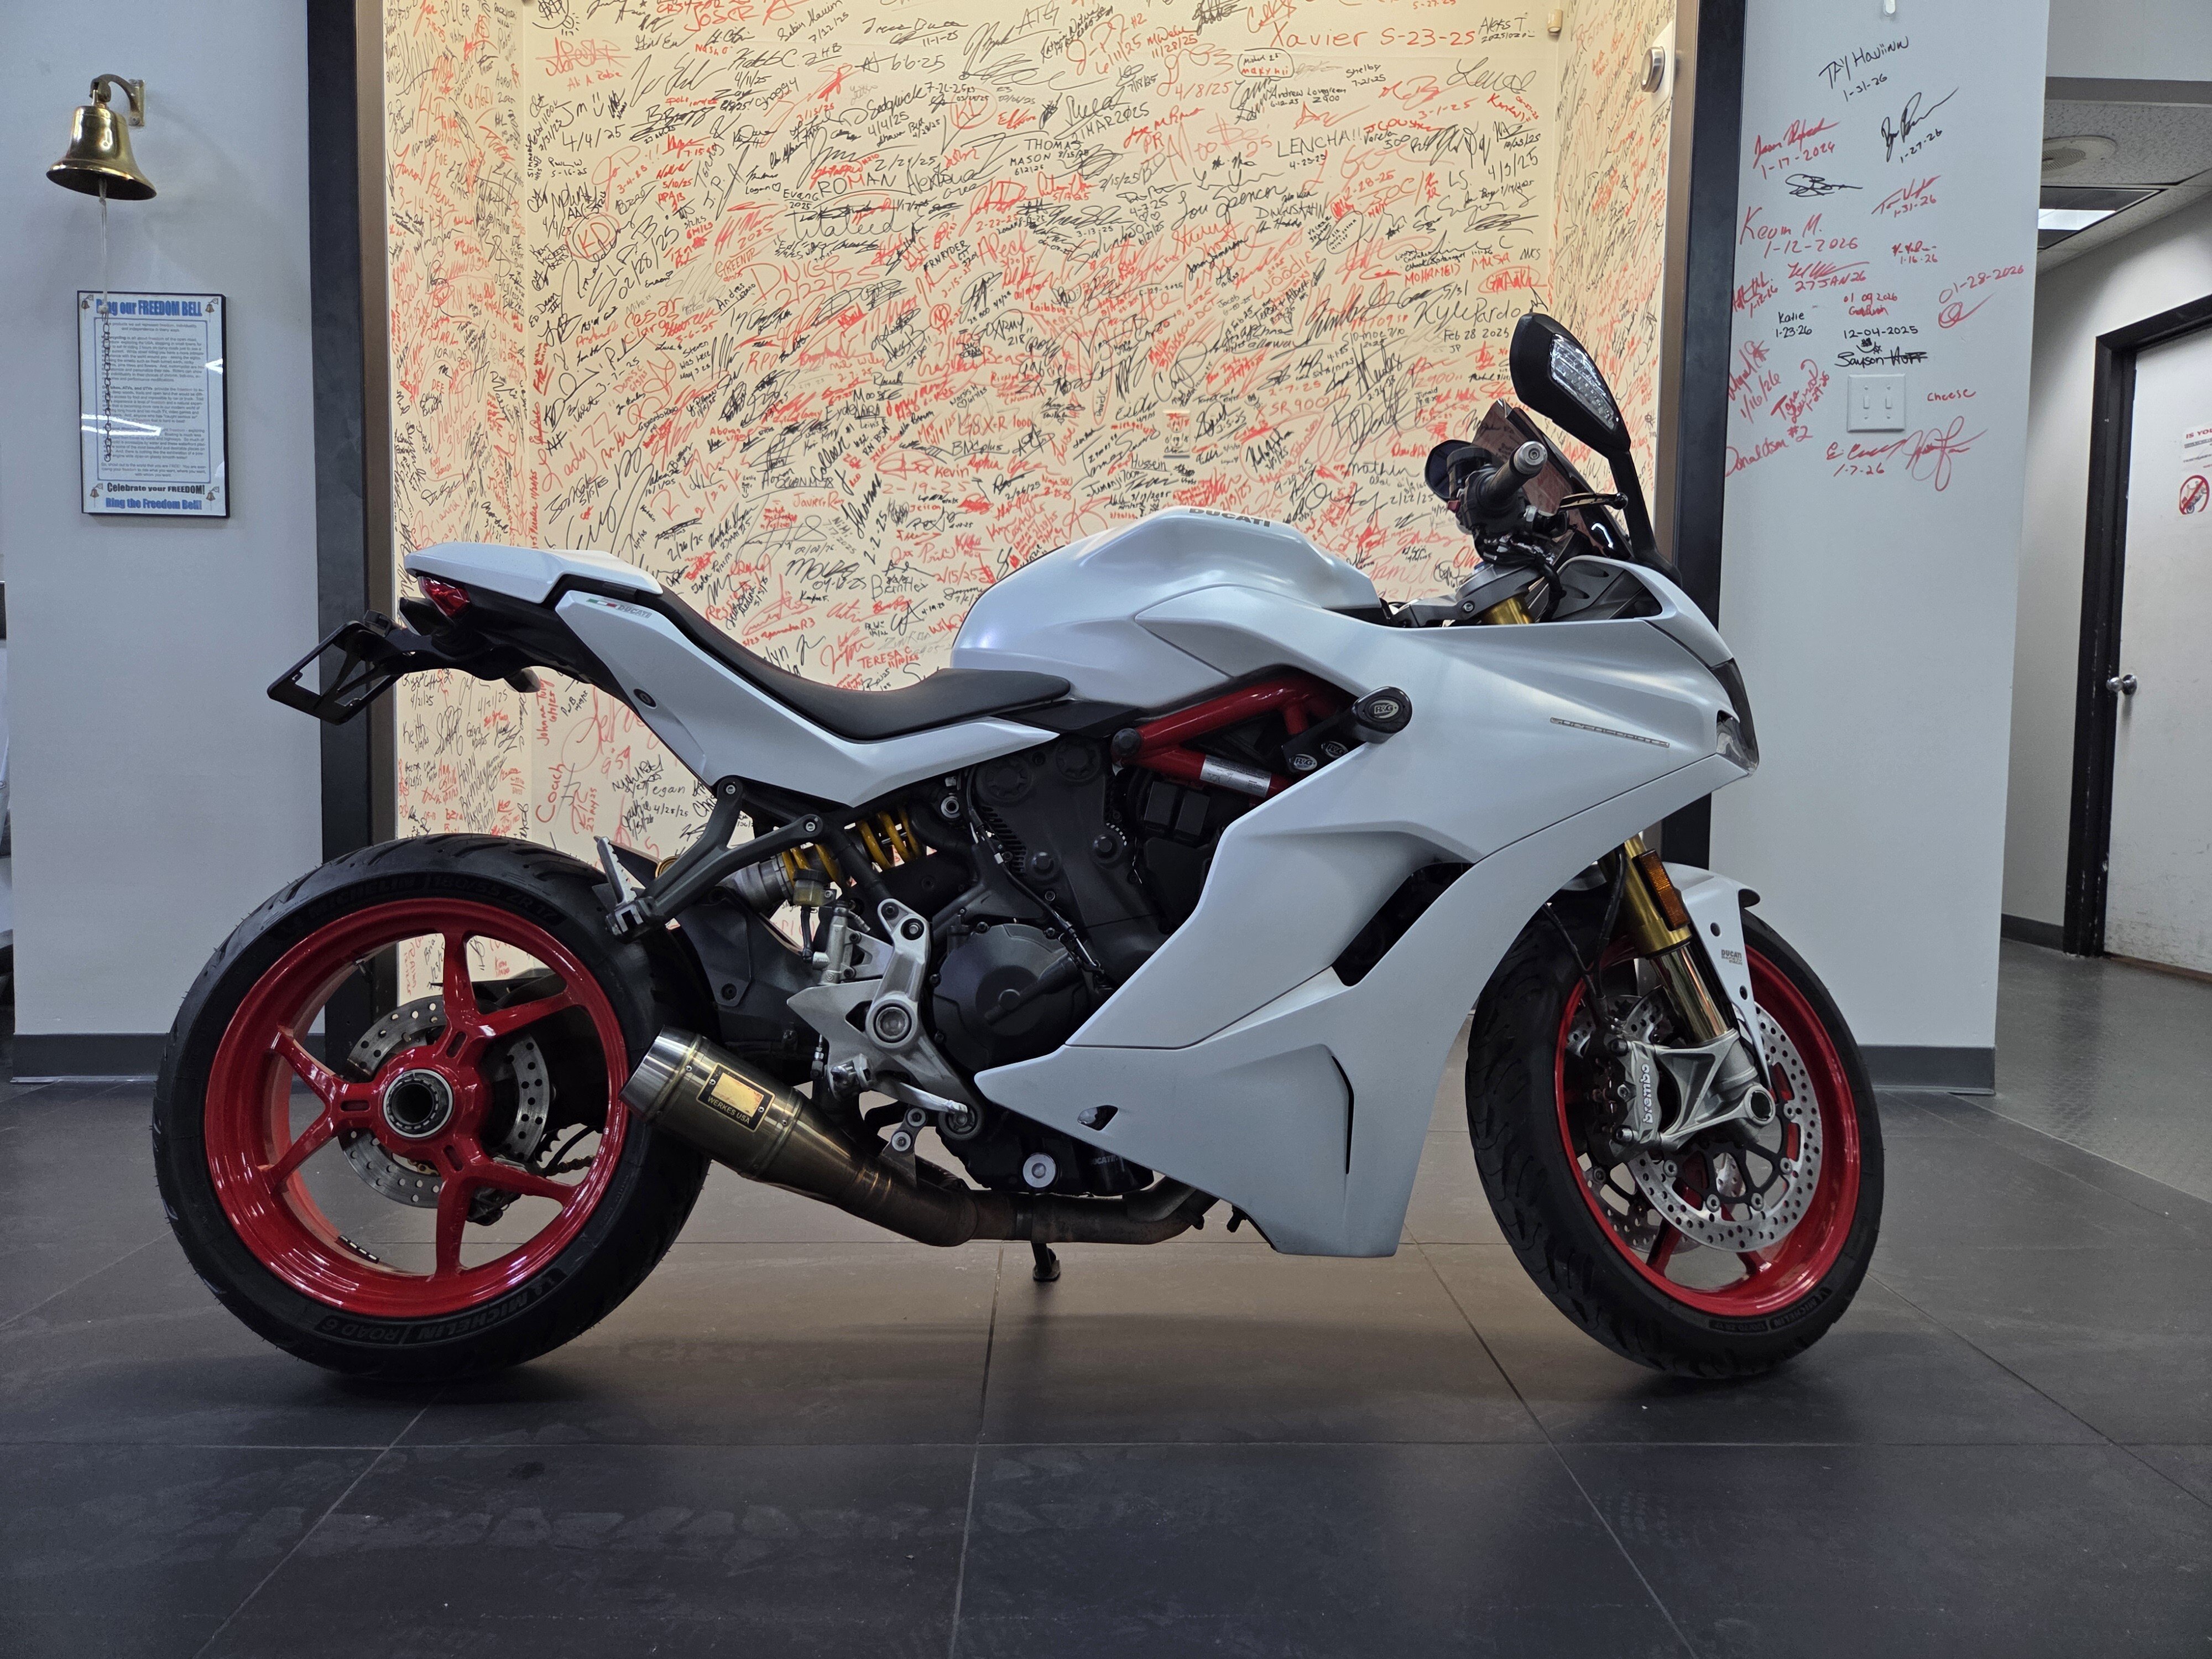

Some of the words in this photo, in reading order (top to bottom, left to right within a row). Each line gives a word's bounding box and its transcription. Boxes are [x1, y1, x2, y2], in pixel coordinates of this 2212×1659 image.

[1271, 22, 1369, 48] Xavier
[1010, 153, 1051, 166] MASON
[818, 173, 896, 195] ROMAN
[1764, 237, 1859, 259] 1-12-2026
[1939, 265, 2024, 304] 01-28-2026
[138, 300, 180, 316] FREEDOM
[181, 301, 202, 316] BELL
[1464, 328, 1475, 339] 28
[1844, 325, 1918, 339] 12-04-2025
[935, 465, 970, 479] Kevin
[107, 482, 147, 492] Celebrate
[168, 485, 205, 495] FREEDOM!
[106, 497, 126, 509] Ring
[127, 498, 142, 508] the
[143, 499, 181, 509] Freedom
[1189, 508, 1270, 528] DUCATI
[617, 604, 653, 619] DUCATI
[858, 653, 895, 669] TERESA
[1374, 704, 1393, 714] R&G
[1295, 757, 1313, 766] R&G
[1721, 950, 1742, 959] DUCATI
[1641, 1064, 1653, 1124] brembo
[708, 1095, 736, 1117] WERKES
[737, 1112, 750, 1124] USA
